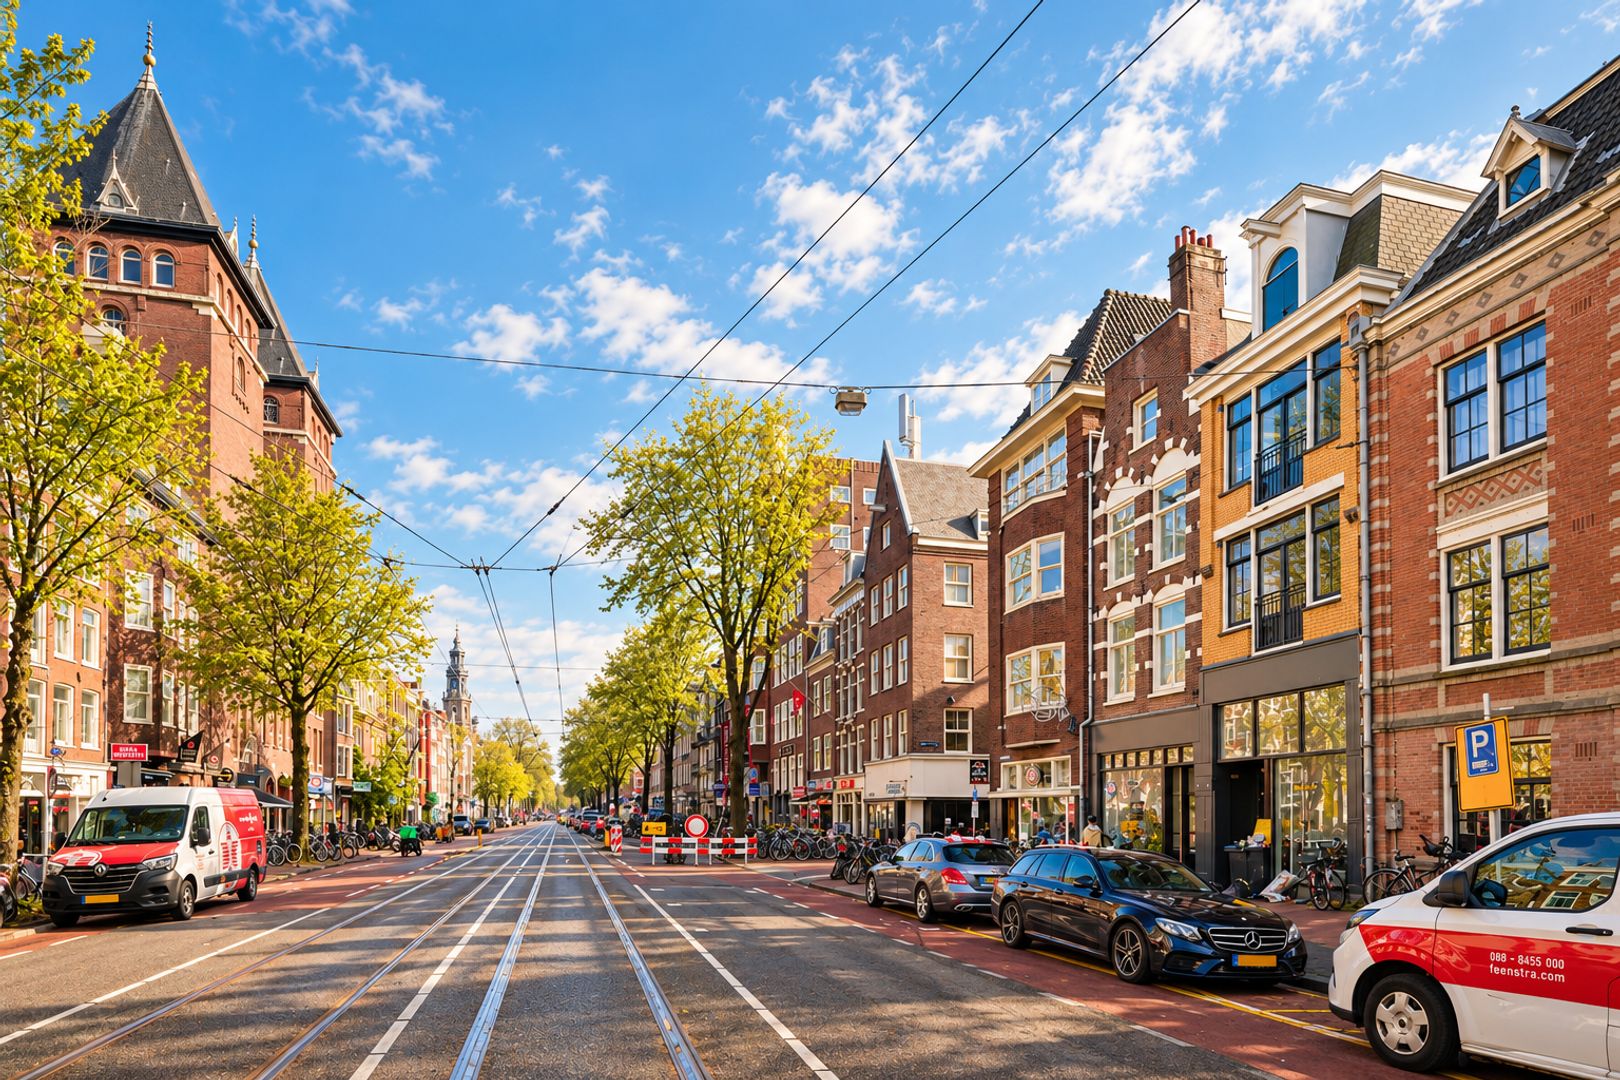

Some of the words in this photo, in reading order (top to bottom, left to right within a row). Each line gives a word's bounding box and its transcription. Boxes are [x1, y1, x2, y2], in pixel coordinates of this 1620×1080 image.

[1471, 730, 1490, 759] P
[1489, 951, 1507, 963] 088
[1517, 954, 1542, 967] 8455
[1545, 957, 1565, 970] 000
[1489, 963, 1565, 983] feenstra.com
